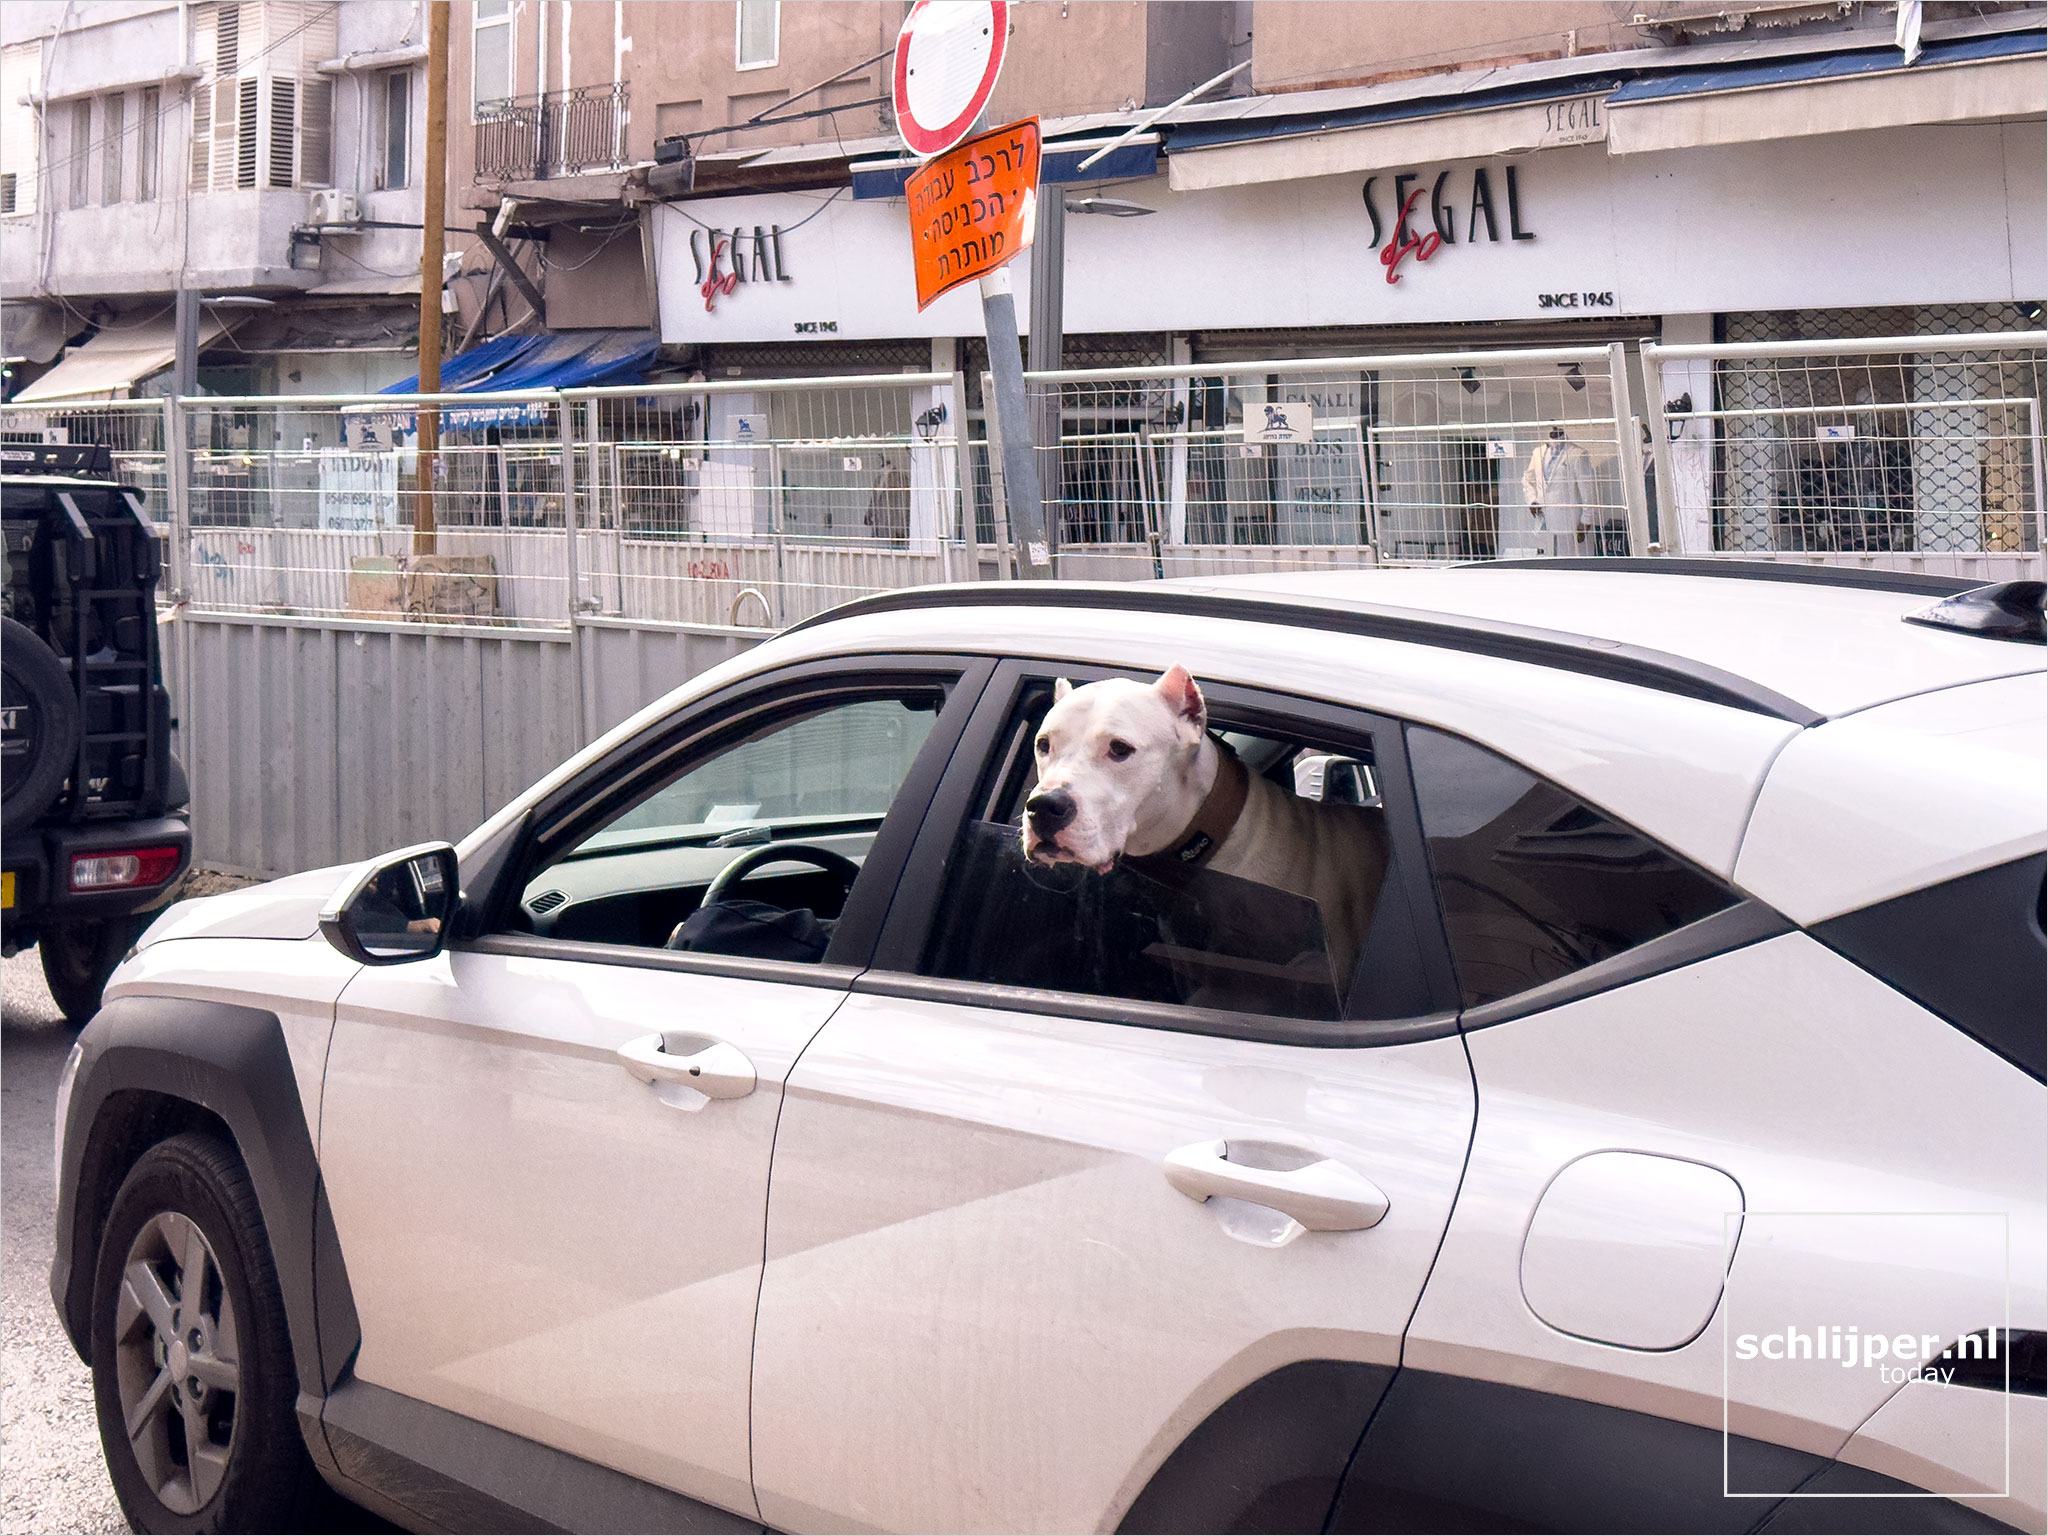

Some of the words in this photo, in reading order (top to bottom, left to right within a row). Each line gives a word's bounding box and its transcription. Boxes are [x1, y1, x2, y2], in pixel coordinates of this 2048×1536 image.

[1545, 99, 1600, 132] SEGAL
[965, 139, 1024, 185] לרכב
[915, 168, 954, 216] עבודה
[1362, 165, 1537, 249] SEGAL
[932, 192, 1005, 243] הכניסה
[689, 224, 791, 285] SEGAL
[938, 231, 1005, 280] מותרת
[1538, 292, 1578, 308] SINCE
[1582, 291, 1613, 306] 1945
[794, 321, 818, 334] SINCE
